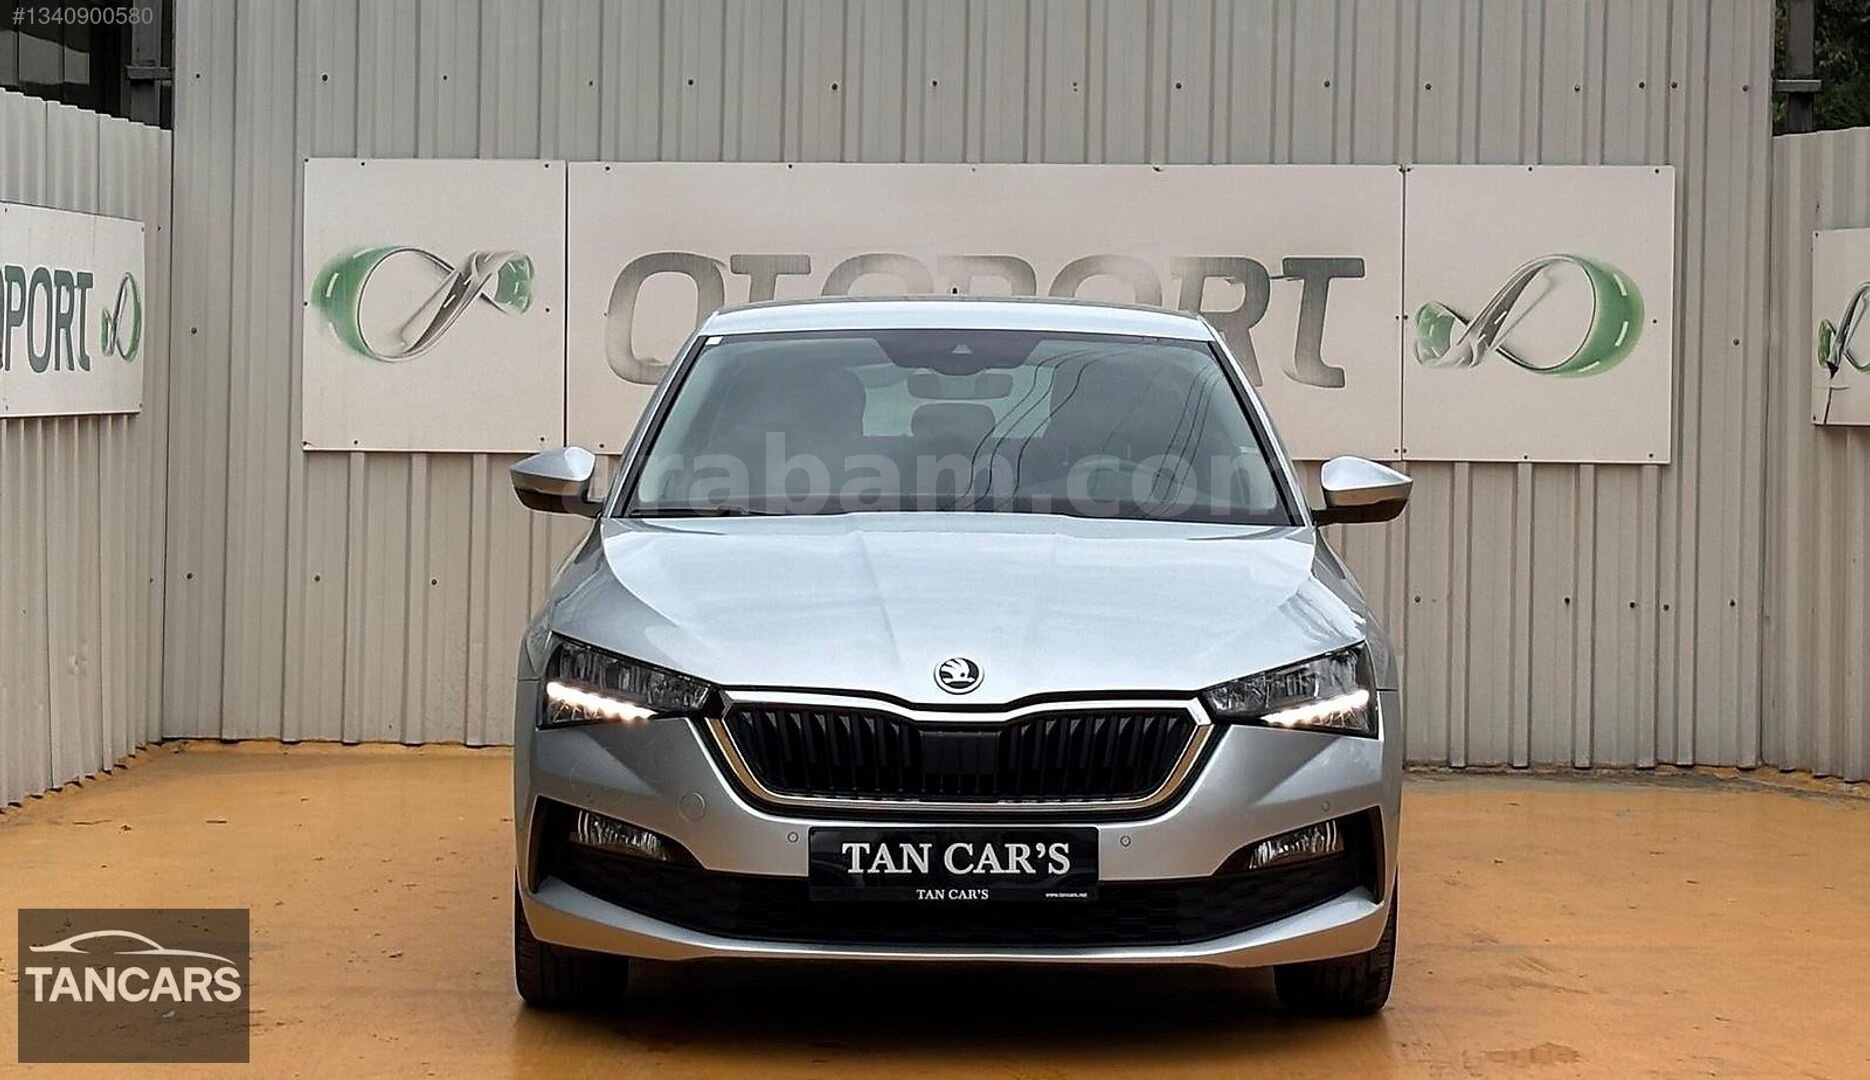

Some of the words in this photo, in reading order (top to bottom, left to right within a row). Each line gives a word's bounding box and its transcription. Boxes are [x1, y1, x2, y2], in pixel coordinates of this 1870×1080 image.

[0, 264, 94, 374] PORT
[841, 843, 932, 874] TAN
[944, 843, 1070, 875] CAR'S
[916, 889, 946, 900] TAN
[948, 889, 989, 901] CAR'S
